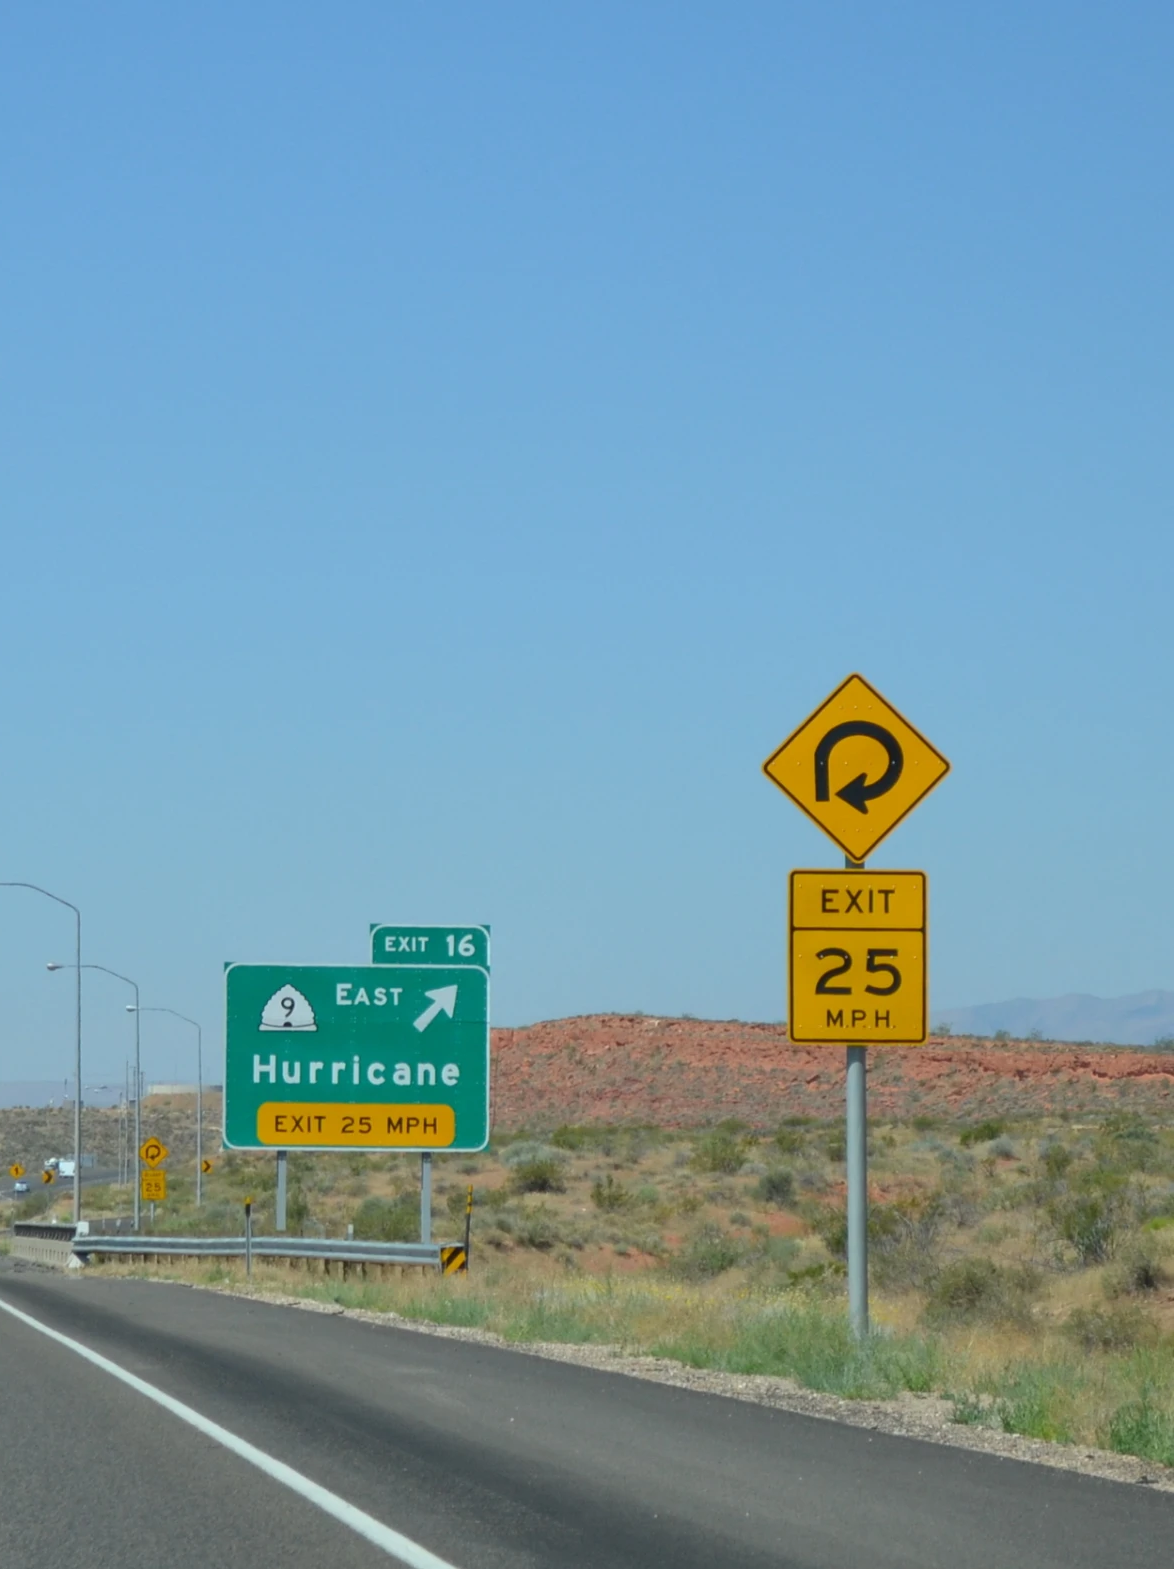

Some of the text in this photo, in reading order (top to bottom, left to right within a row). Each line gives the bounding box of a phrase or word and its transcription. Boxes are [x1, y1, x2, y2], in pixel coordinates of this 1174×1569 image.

[821, 888, 896, 914] EXIT
[384, 934, 476, 957] EXIT 16
[814, 947, 902, 997] 25
[335, 983, 403, 1006] EAST
[280, 996, 296, 1018] 9
[252, 1054, 461, 1087] Hurricane
[274, 1115, 438, 1135] EXIT 25 MPH
[145, 1182, 162, 1193] 25
